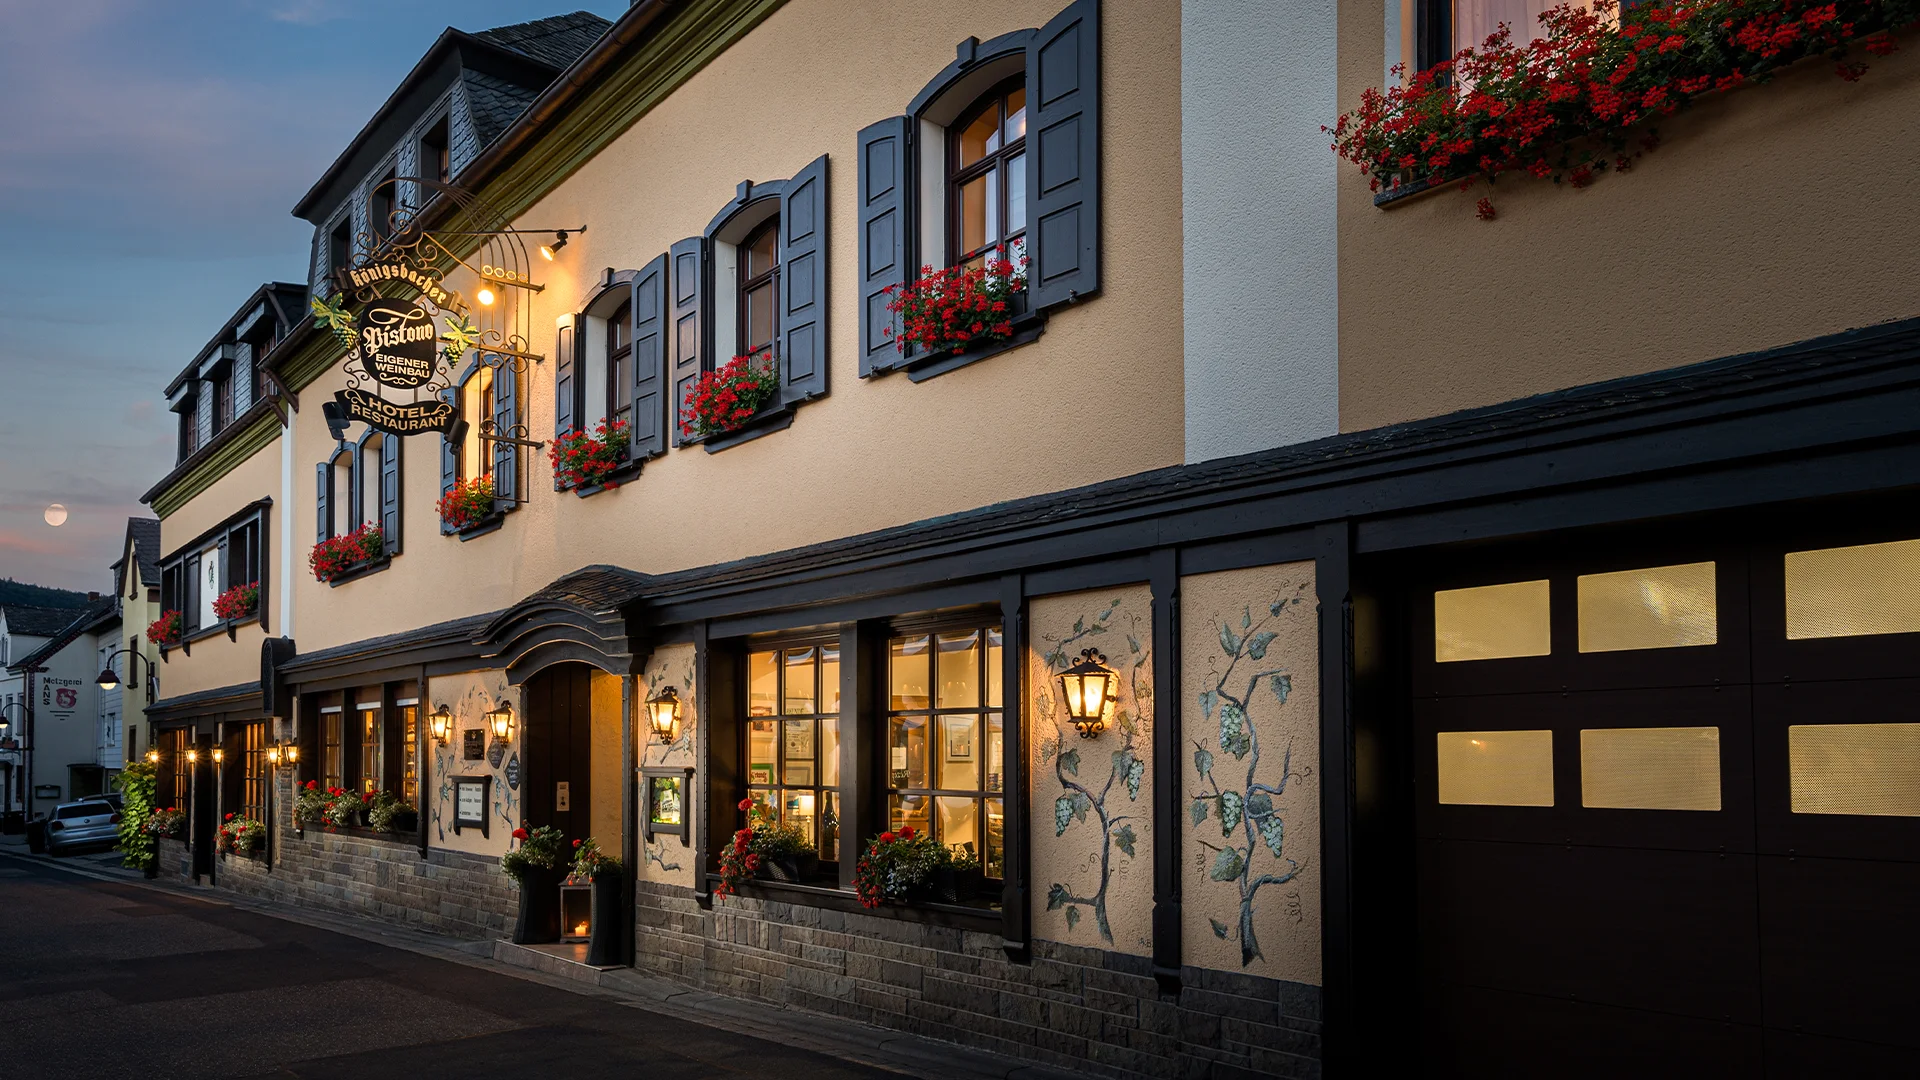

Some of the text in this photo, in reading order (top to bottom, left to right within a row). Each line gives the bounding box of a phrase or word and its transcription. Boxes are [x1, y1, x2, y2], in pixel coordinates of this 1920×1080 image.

[350, 263, 447, 304] Königsbacher
[363, 308, 434, 358] Pistono
[375, 353, 429, 370] EIGENER
[375, 362, 430, 378] WEINBAU
[351, 404, 447, 430] RESTAURANT
[369, 397, 430, 418] HOTEL
[43, 676, 82, 687] Metzgerei
